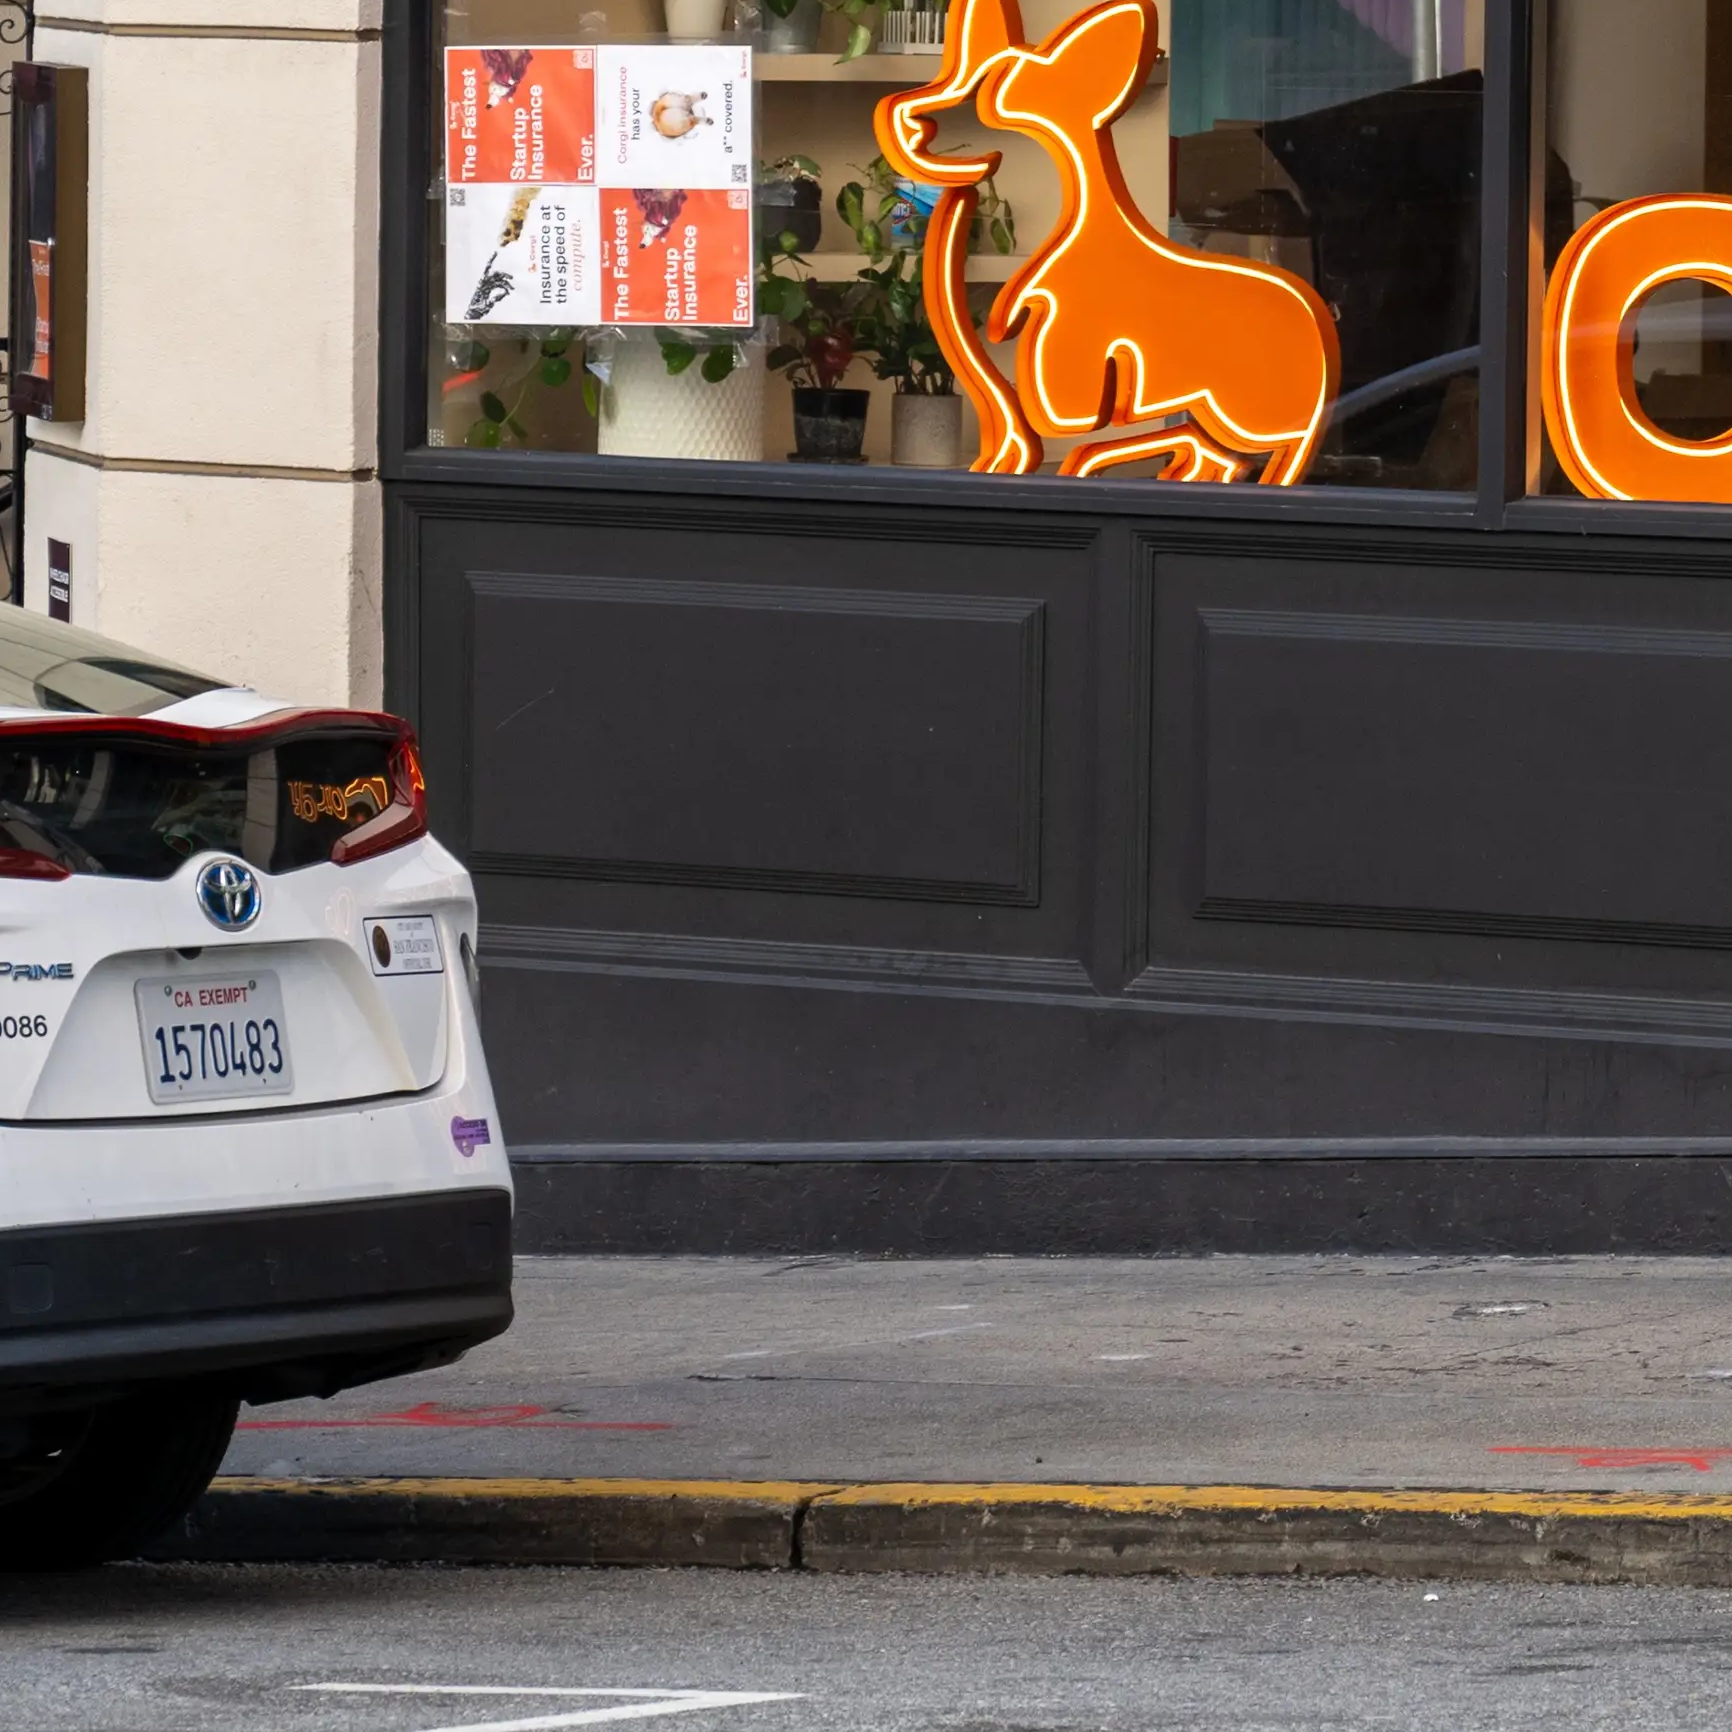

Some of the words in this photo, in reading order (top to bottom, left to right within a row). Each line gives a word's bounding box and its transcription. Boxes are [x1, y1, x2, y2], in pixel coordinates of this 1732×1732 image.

[462, 68, 476, 139] Fastest
[618, 66, 627, 128] insurance
[632, 88, 643, 116] your
[722, 80, 733, 133] covered.
[510, 108, 529, 180] Startup
[528, 84, 544, 179] Insurance
[618, 129, 629, 164] Corgi
[630, 118, 640, 141] has
[462, 144, 476, 181] The
[578, 134, 593, 180] Ever.
[540, 205, 551, 221] at
[554, 205, 565, 221] of
[540, 225, 551, 304] Insurance
[554, 226, 569, 274] speed
[570, 219, 585, 292] compute.
[613, 207, 628, 278] Fastest
[555, 278, 567, 304] the
[664, 248, 681, 321] Startup
[683, 225, 698, 321] Insurance
[614, 284, 629, 320] The
[733, 275, 748, 321] Ever.
[174, 989, 194, 1008] CA
[198, 986, 249, 1006] EXEMPT
[155, 1018, 283, 1084] 1570483
